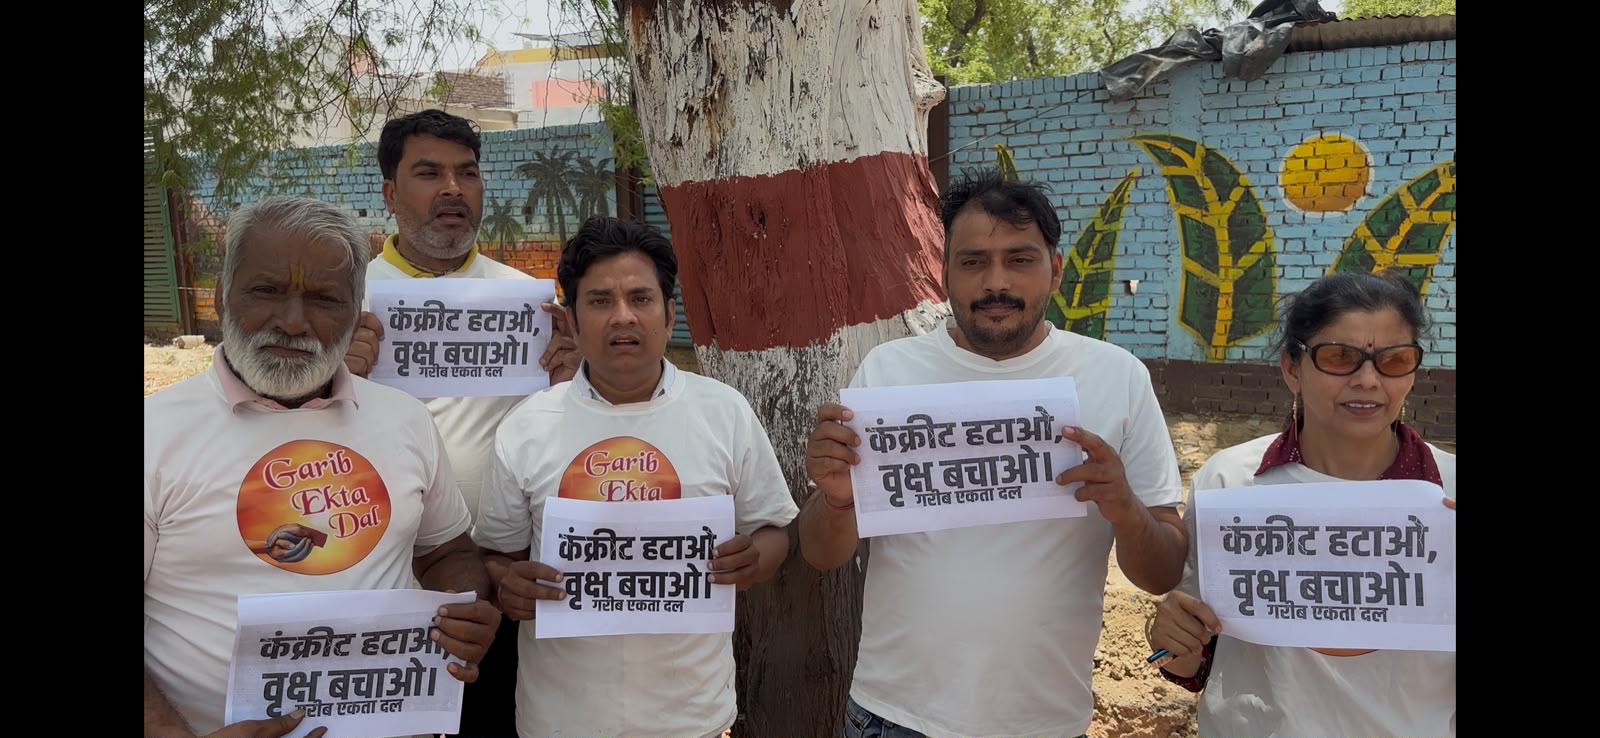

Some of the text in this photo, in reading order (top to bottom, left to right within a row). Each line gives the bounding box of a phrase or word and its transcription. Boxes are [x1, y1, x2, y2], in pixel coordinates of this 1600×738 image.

[388, 300, 540, 336] कंक्रीट हटाओ,
[392, 335, 528, 376] वृक्ष बचाओ।
[419, 363, 503, 378] गरीब एकता दल
[865, 405, 1063, 453] कंक्रीट हटाओ,
[265, 450, 352, 489] Garib
[585, 450, 659, 476] Garib
[879, 444, 1053, 507] वृक्ष बचाओ।
[292, 485, 369, 516] Ekta
[599, 479, 661, 502] Ekta
[915, 485, 1022, 507] गरीब एकता दल
[329, 506, 380, 539] Dal
[1220, 514, 1438, 564] कंक्रीट हटाओ,
[558, 526, 635, 562] कंक्रीट
[563, 571, 612, 610] वृक्ष
[592, 595, 684, 612] गरीब एकता दल
[1229, 560, 1424, 616] वृक्ष बचाओ।
[1267, 600, 1388, 622] गरीब एकता दल
[260, 626, 356, 660] कंक्रीट
[262, 657, 438, 718] वृक्ष बचाओ।
[337, 700, 376, 715] एकता
[380, 698, 404, 713] दल
